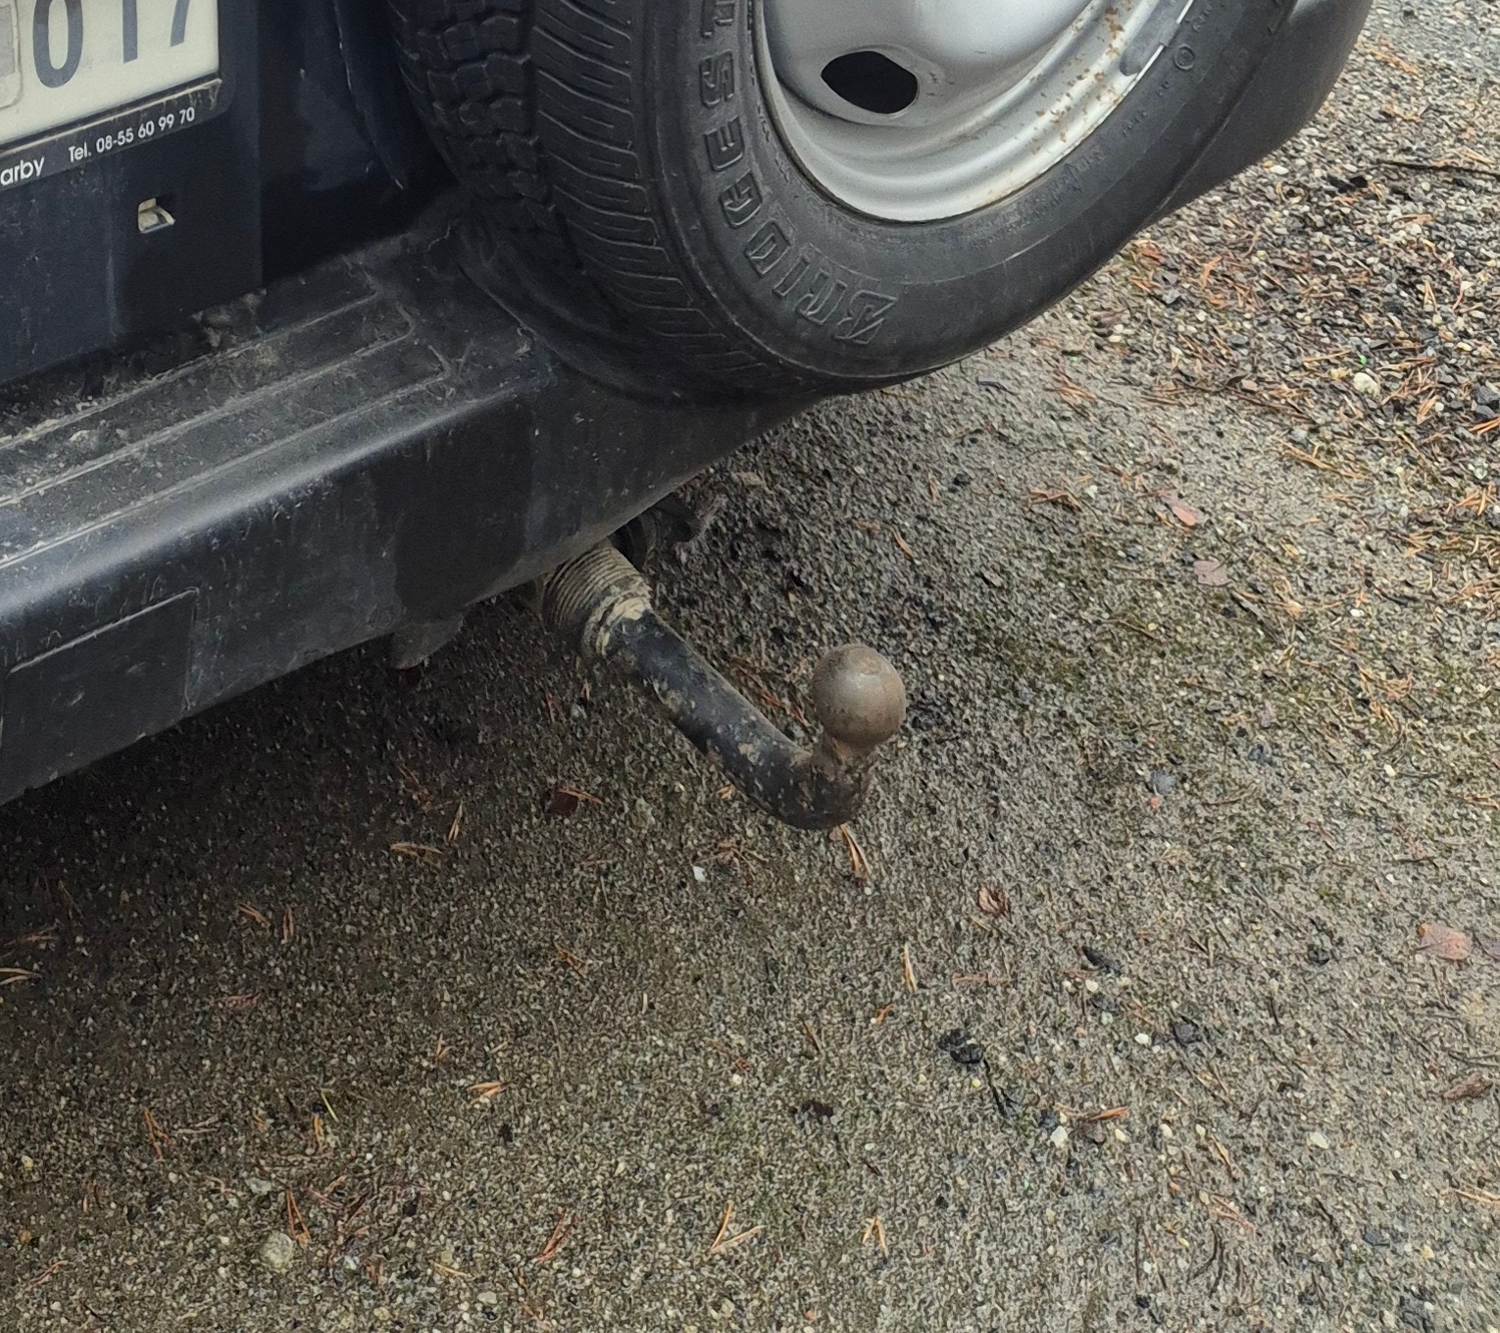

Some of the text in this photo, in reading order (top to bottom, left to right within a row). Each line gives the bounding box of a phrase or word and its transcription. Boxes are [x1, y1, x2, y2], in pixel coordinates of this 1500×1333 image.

[68, 106, 195, 164] Tel. 08-55 60 99 70
